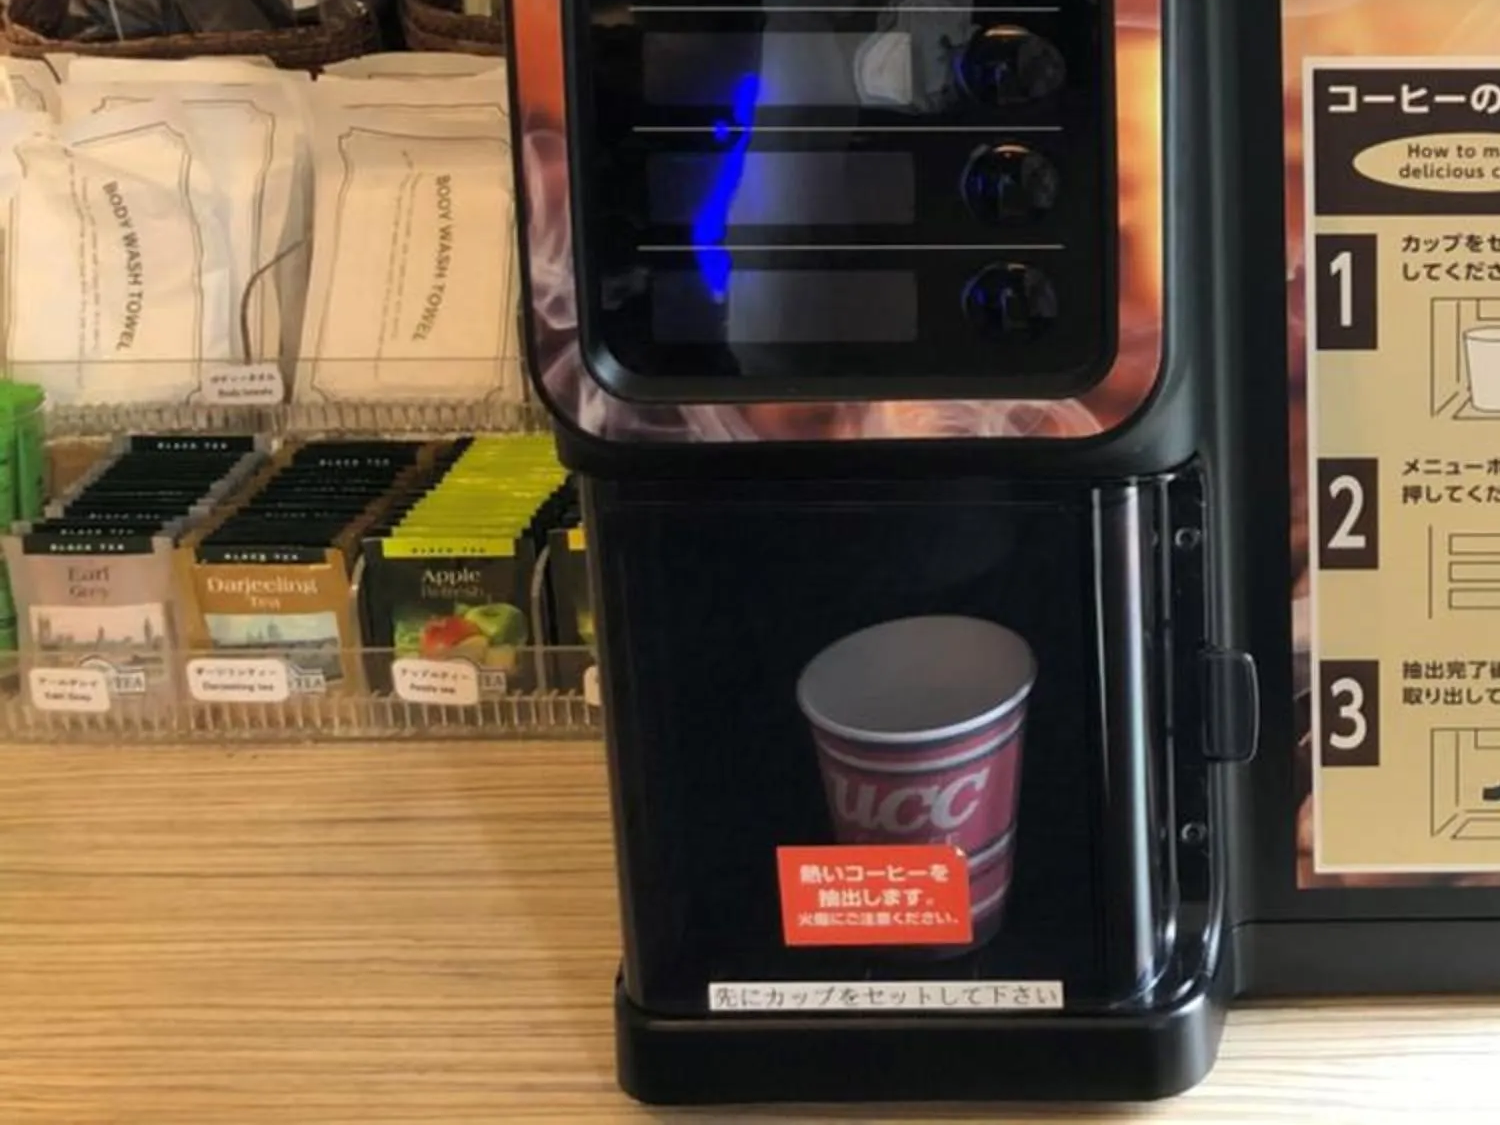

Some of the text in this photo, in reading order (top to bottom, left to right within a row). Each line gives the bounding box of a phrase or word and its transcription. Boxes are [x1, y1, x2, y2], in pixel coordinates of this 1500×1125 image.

[1407, 144, 1449, 159] How
[1455, 145, 1477, 159] to
[1398, 163, 1485, 179] delicious
[102, 181, 145, 351] BODY WASH TOWEL
[411, 174, 453, 341] BODY WASH TOWEL
[1330, 251, 1353, 327] 1
[1327, 475, 1367, 550] 2
[68, 565, 110, 582] Earl
[422, 567, 481, 586] Apple
[207, 576, 318, 594] Darjeeling
[251, 597, 281, 609] Tea
[1330, 677, 1367, 750] 3
[800, 864, 950, 884] 熱いコーヒーを
[818, 888, 935, 907] 抽出します。
[715, 985, 1058, 1007] 先にカップをセットして下さい
